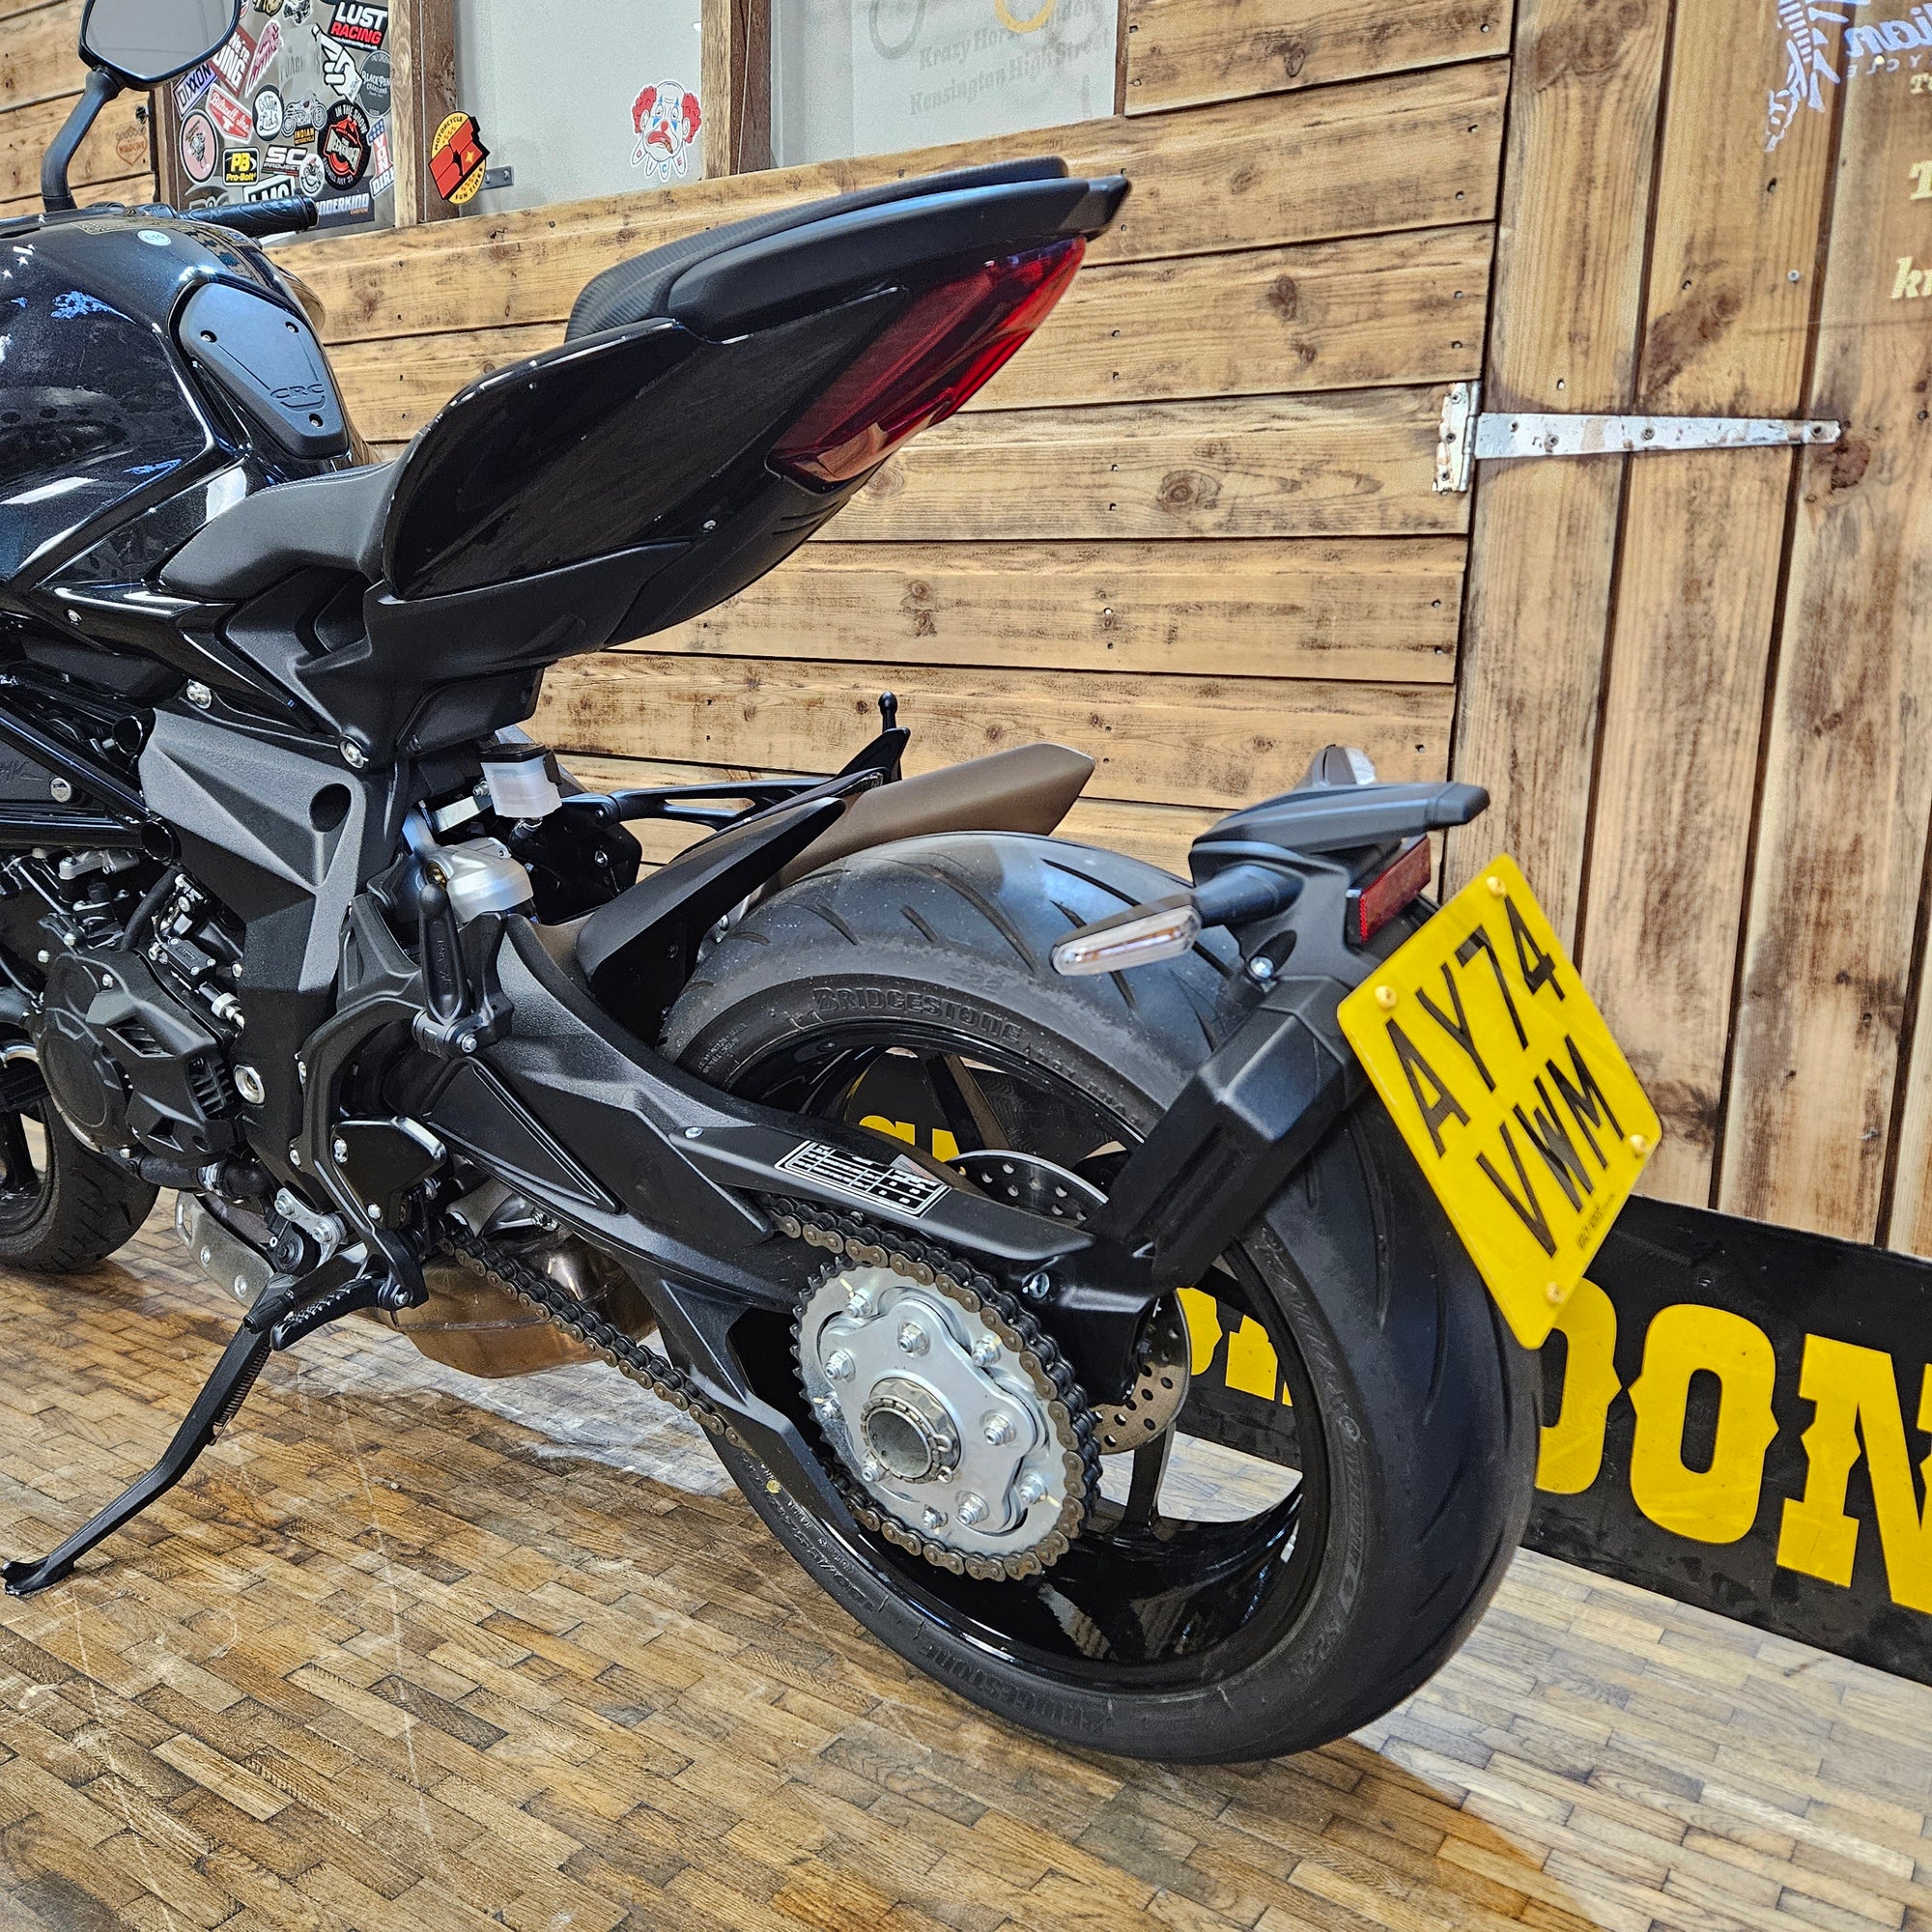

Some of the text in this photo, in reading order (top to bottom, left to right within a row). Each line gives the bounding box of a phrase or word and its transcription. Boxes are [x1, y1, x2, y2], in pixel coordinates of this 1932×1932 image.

[334, 2, 388, 30] LUST
[330, 21, 383, 45] RACING
[177, 63, 212, 107] DIXXON
[294, 127, 315, 139] INDIAN
[334, 105, 342, 118] IN
[354, 108, 368, 134] SHOW
[435, 116, 463, 151] MOTORCYCLE
[231, 153, 251, 172] PB
[266, 146, 308, 165] SC
[225, 173, 254, 182] Pro-Bolt
[469, 166, 483, 193] TIMES
[316, 193, 369, 214] NDERKIND
[812, 986, 1024, 1044] BRIDGESTONE
[1384, 895, 1566, 1158] AY74
[1476, 1035, 1625, 1259] VWM
